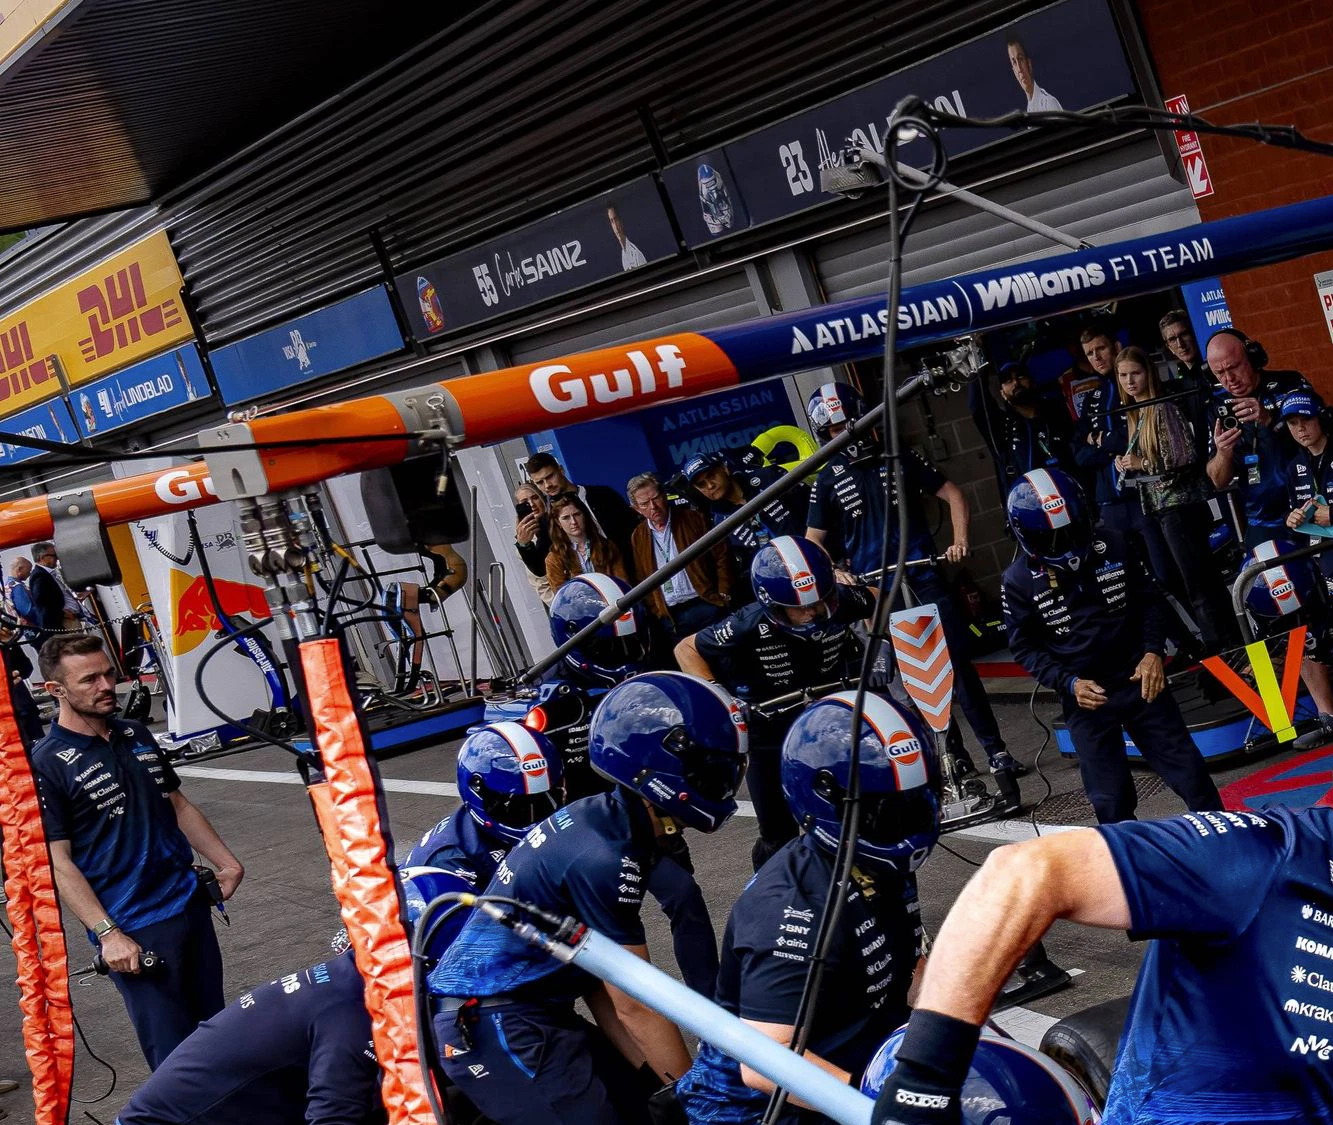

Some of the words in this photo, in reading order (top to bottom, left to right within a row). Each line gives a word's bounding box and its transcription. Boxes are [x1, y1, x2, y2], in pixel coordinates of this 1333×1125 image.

[779, 140, 815, 196] 23
[472, 263, 499, 307] 55
[521, 240, 587, 284] SAINZ
[815, 296, 958, 348] ATLASSIAN
[973, 260, 1105, 312] Williams
[1109, 257, 1137, 282] F1
[1143, 238, 1214, 273] TEAM
[530, 343, 686, 413] Gulf
[125, 375, 174, 407] LINDBLAD
[678, 389, 774, 427] ATLASSIAN
[1044, 500, 1064, 511] Gulf
[794, 577, 815, 588] Gulf
[1097, 569, 1125, 583] Williams
[1272, 581, 1292, 597] Gulf
[1048, 606, 1068, 616] Claude
[244, 637, 275, 675] Airtasker
[889, 741, 919, 757] Gulf
[522, 758, 547, 772] Gulf
[83, 772, 111, 790] KOMATSU
[97, 782, 119, 797] Claude
[786, 924, 811, 935] BNY
[787, 937, 808, 949] airia
[772, 950, 805, 962] nuveen
[896, 1088, 951, 1110] sparco
